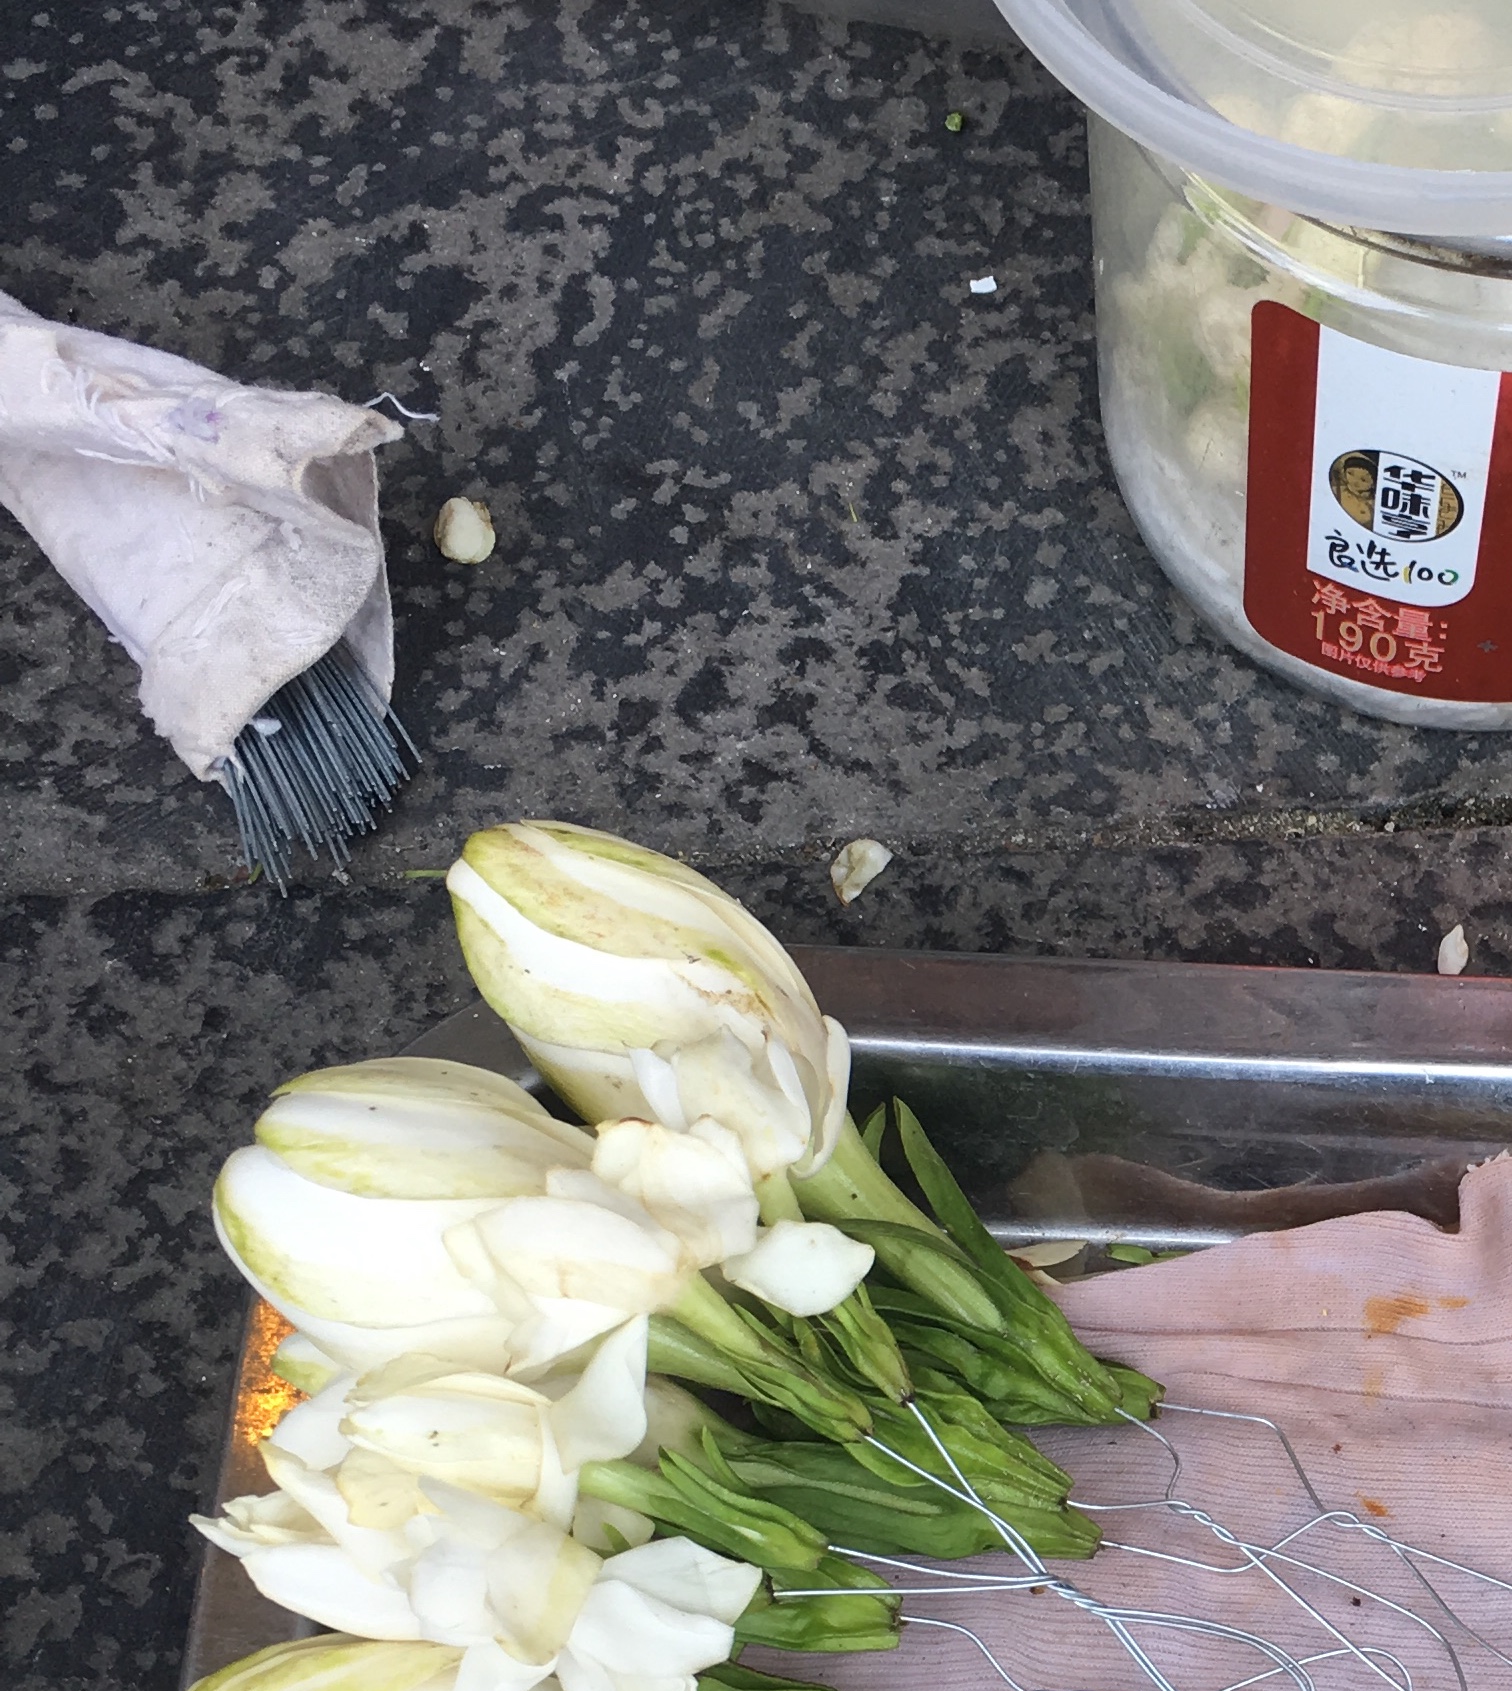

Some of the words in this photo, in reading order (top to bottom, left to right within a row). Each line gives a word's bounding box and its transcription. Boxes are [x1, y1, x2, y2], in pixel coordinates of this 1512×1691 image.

[1380, 464, 1436, 539] 华味享
[1324, 528, 1459, 586] 良选100
[1311, 609, 1446, 673] 190克
